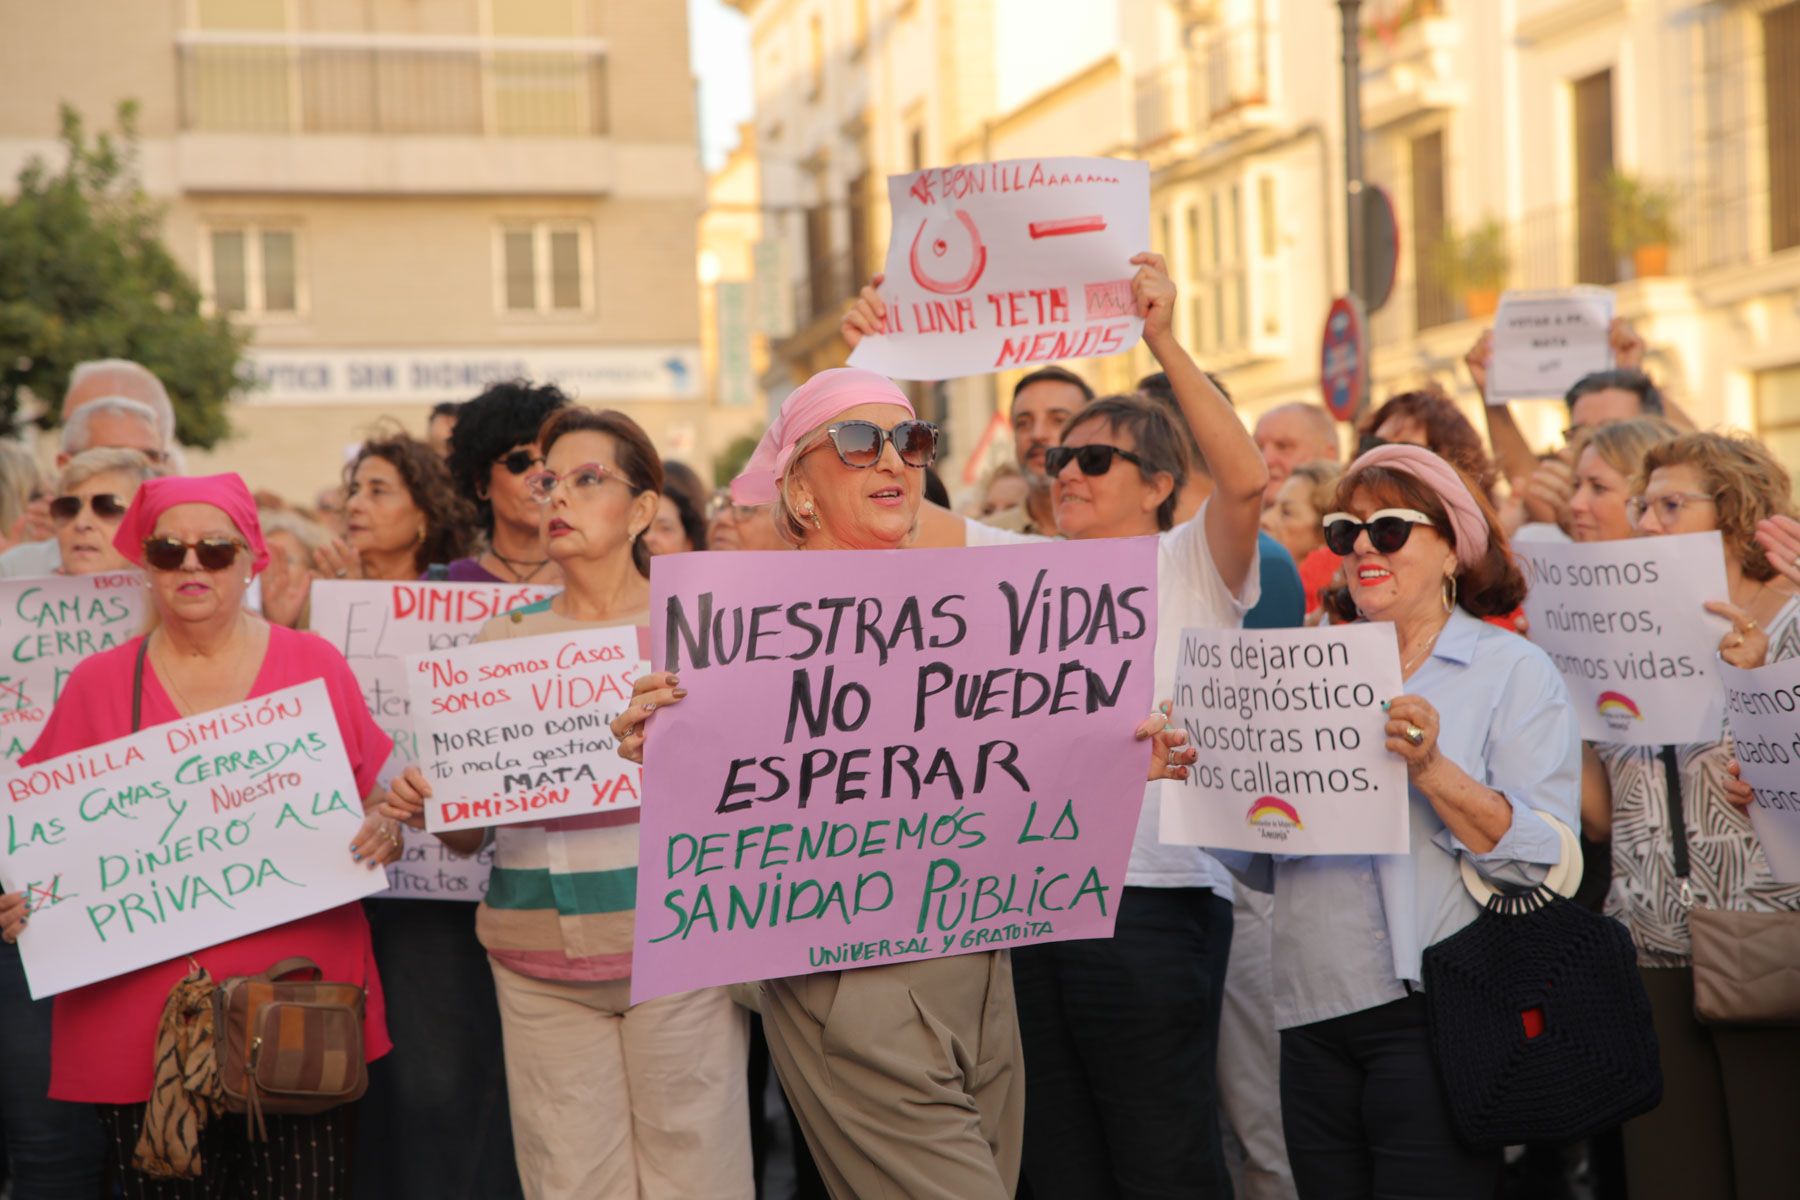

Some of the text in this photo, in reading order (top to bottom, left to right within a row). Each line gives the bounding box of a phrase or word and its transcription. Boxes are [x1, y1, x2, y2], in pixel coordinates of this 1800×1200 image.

[912, 297, 977, 335] UNA
[987, 286, 1070, 328] TETA
[994, 323, 1131, 369] MENOS
[1533, 558, 1659, 587] No somos
[16, 587, 130, 628] CAMAS
[665, 568, 1150, 674] NUESTRAS VIDAS
[1545, 603, 1662, 635] números,
[12, 629, 127, 663] CERRA
[1184, 637, 1349, 679] Nos dejaron
[1549, 651, 1705, 681] omos vidas.
[913, 658, 1132, 733] PUEDEN
[1174, 676, 1386, 719] in diagnóstico.
[7, 697, 303, 802] BONILLA DIMISIÓN
[432, 723, 534, 756] MORENO
[1184, 718, 1361, 752] Nosotras no
[8, 731, 328, 855] LAS CAMAS CERRADAS
[209, 770, 303, 815] Nuestro
[503, 763, 597, 794] MATA
[714, 740, 1031, 815] ESPERAR
[1230, 761, 1379, 794] callamos.
[275, 803, 319, 830] A
[311, 790, 363, 820] LA
[1017, 799, 1080, 846] LA
[86, 858, 307, 942] PRIVADA
[648, 858, 1110, 944] SANIDAD PÚBLICA
[809, 937, 933, 967] UNIVERSAL
